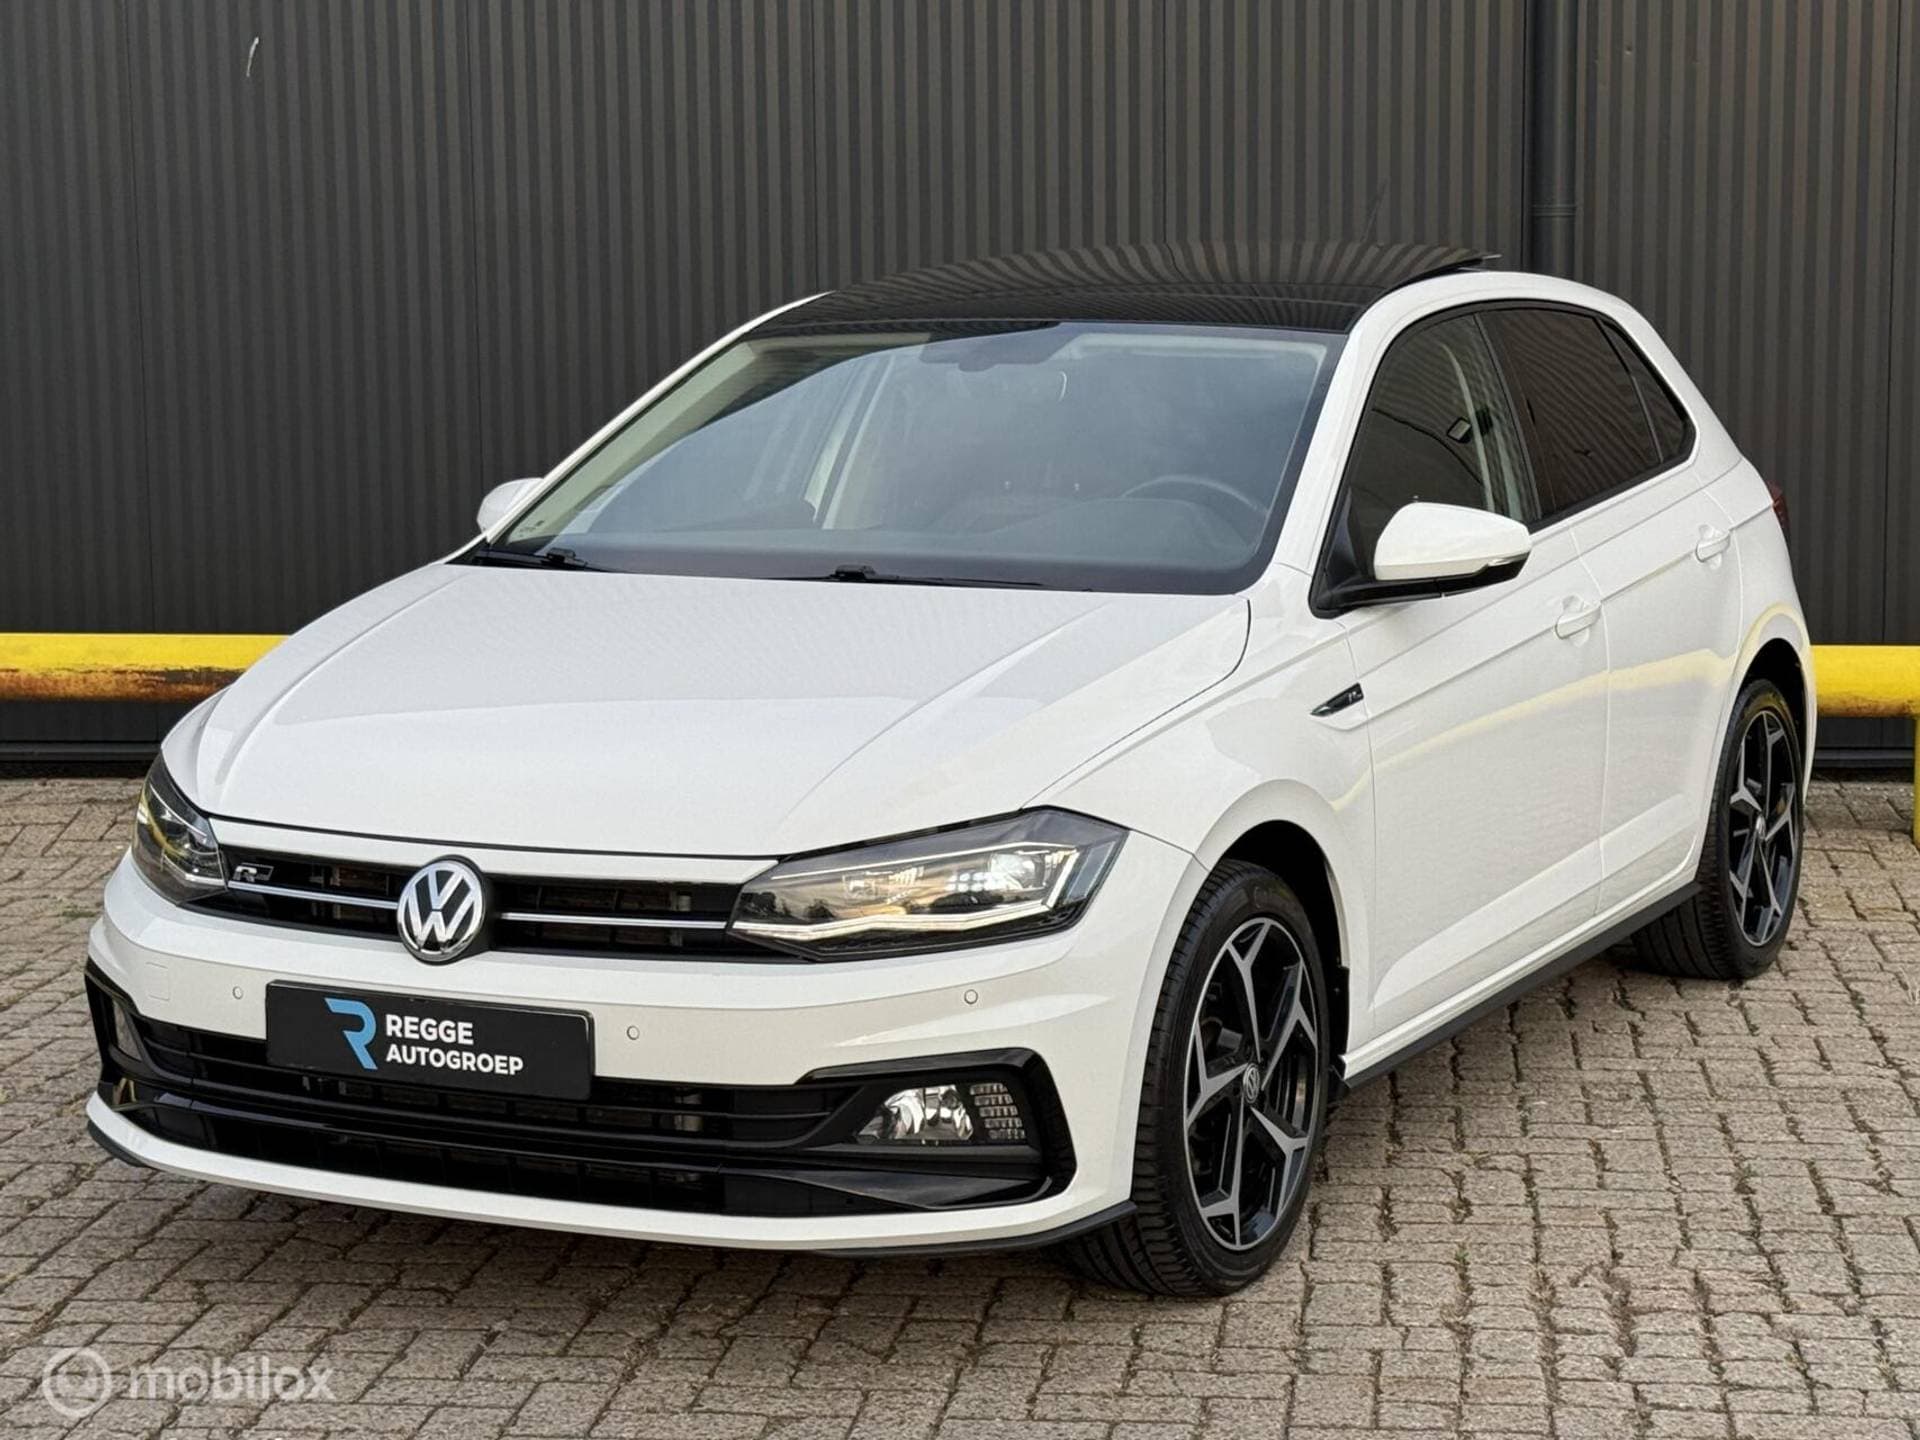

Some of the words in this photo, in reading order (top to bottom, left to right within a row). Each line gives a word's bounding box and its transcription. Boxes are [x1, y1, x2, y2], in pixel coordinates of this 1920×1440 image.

[401, 860, 482, 955] VW
[385, 1013, 474, 1046] REGGE
[385, 1043, 524, 1076] AUTOGROEP
